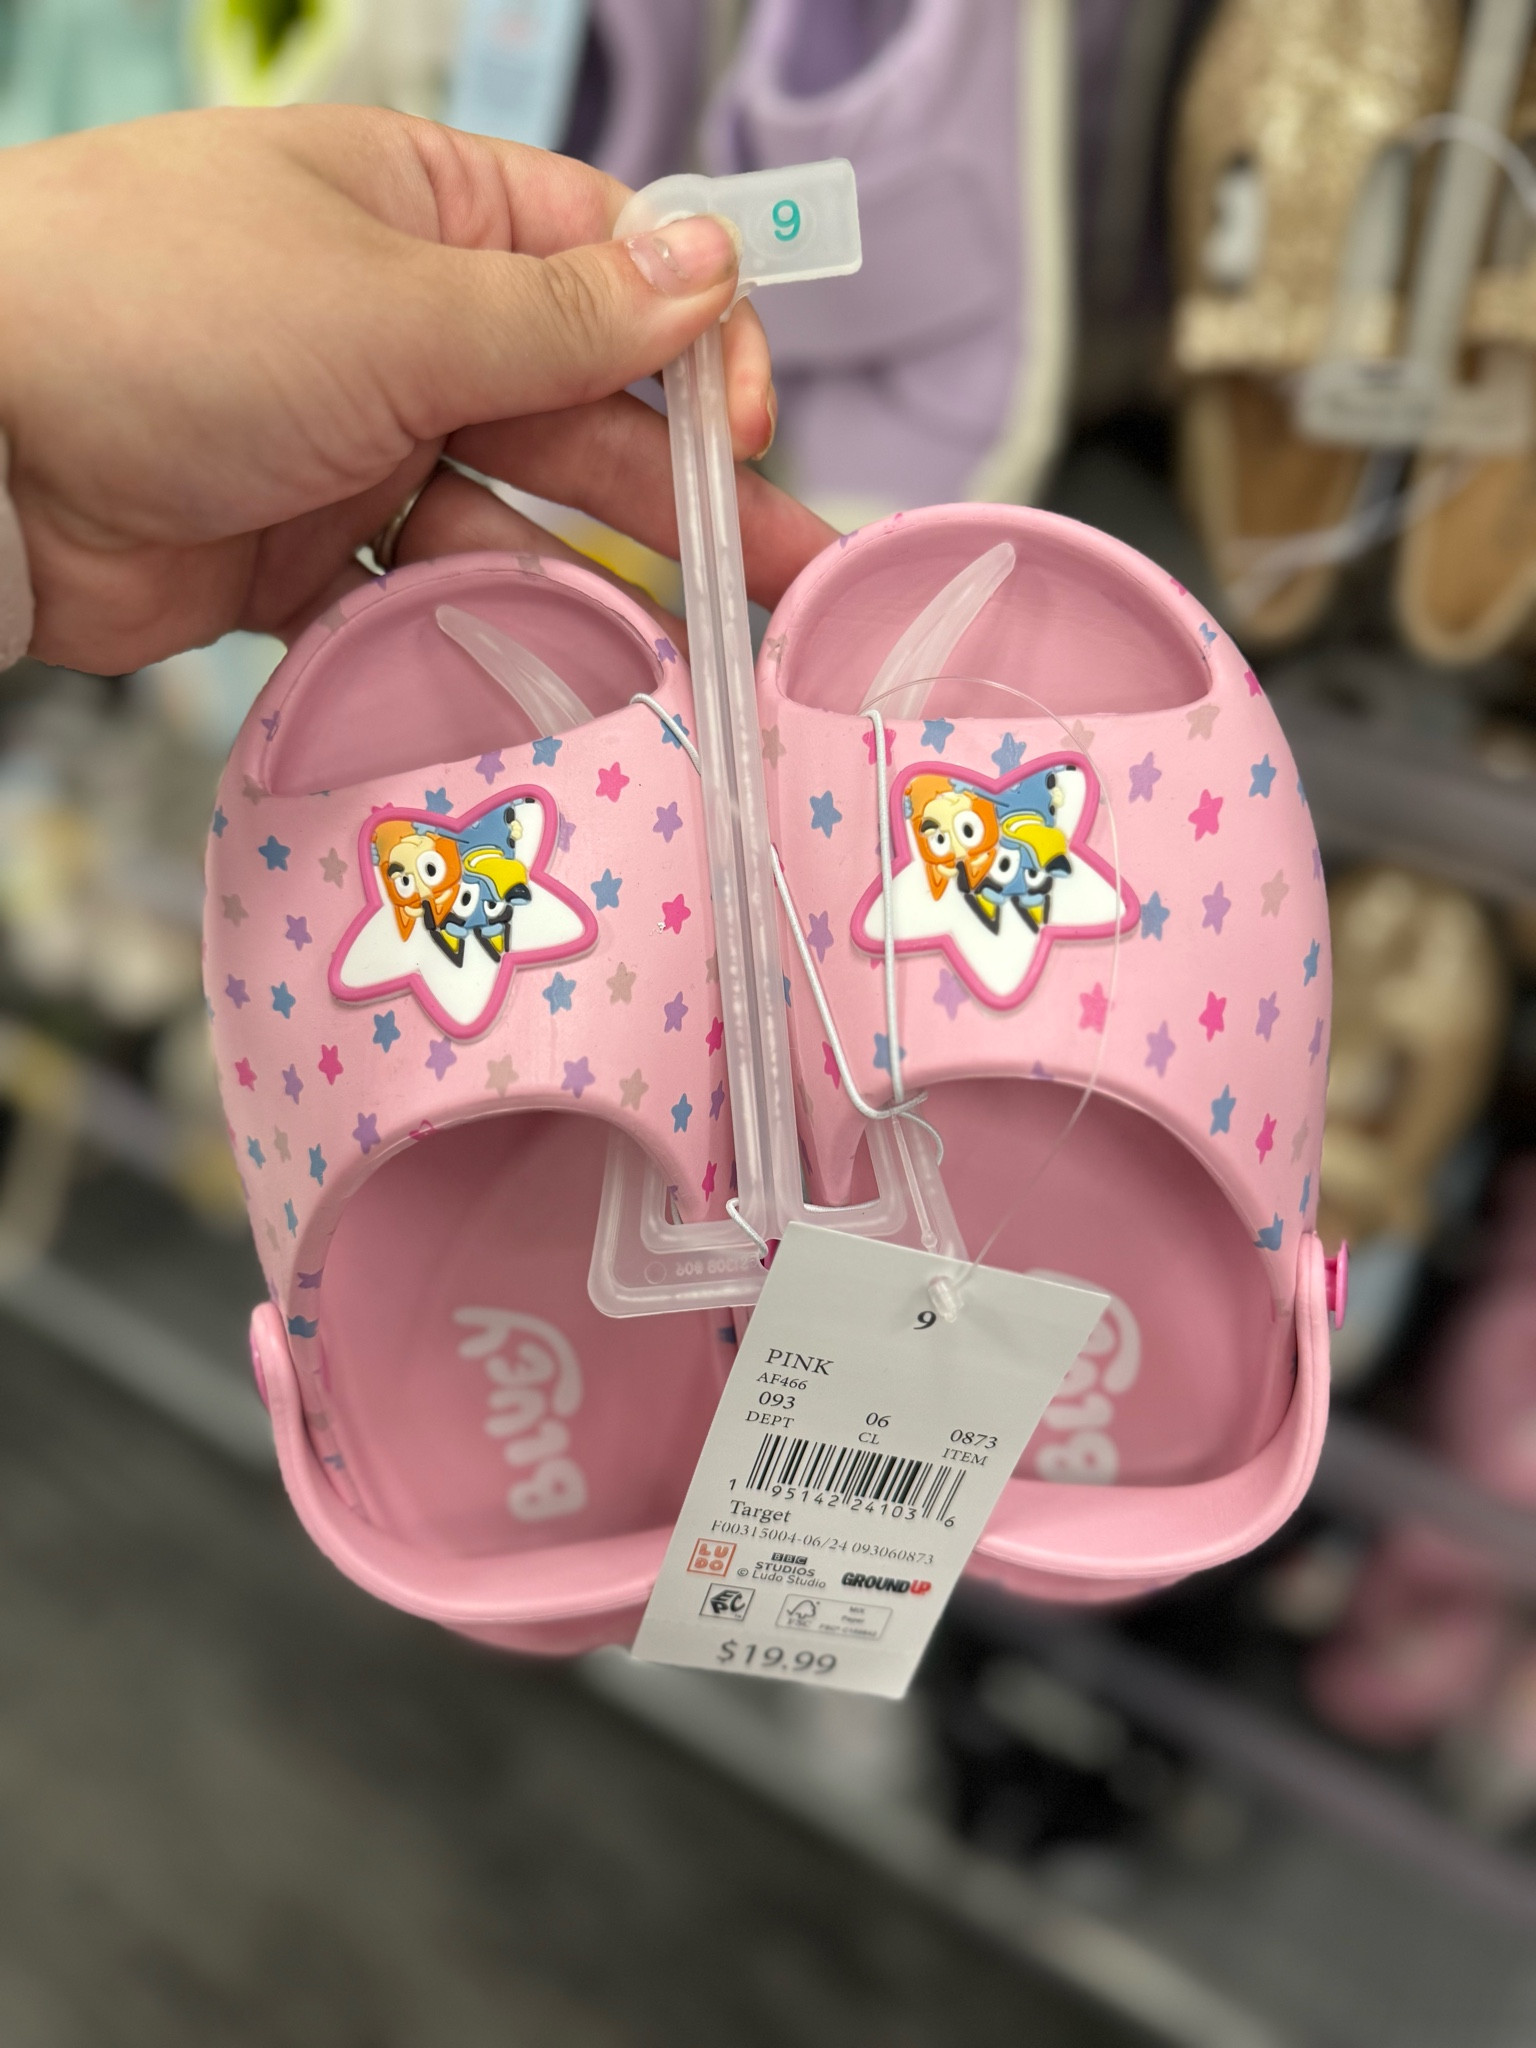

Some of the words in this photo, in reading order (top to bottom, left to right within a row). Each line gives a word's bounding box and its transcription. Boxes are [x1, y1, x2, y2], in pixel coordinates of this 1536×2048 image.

[772, 199, 801, 242] 9
[913, 1310, 937, 1330] 9
[764, 1347, 835, 1376] PINK
[756, 1371, 808, 1390] AF466
[758, 1391, 796, 1410] 093
[865, 1412, 891, 1428] 06
[950, 1429, 998, 1449] 0873
[745, 1410, 795, 1428] DEPT
[858, 1431, 880, 1445] CL
[942, 1447, 989, 1466] ITEM
[730, 1499, 792, 1523] Target
[711, 1519, 847, 1550] F00315004-06/24
[851, 1542, 934, 1565] 093060873
[755, 1561, 816, 1577] STUDIOS
[771, 1552, 808, 1565] BBC
[751, 1569, 783, 1583] Ludo
[786, 1574, 827, 1589] Studio
[717, 1638, 838, 1675] $19.99
